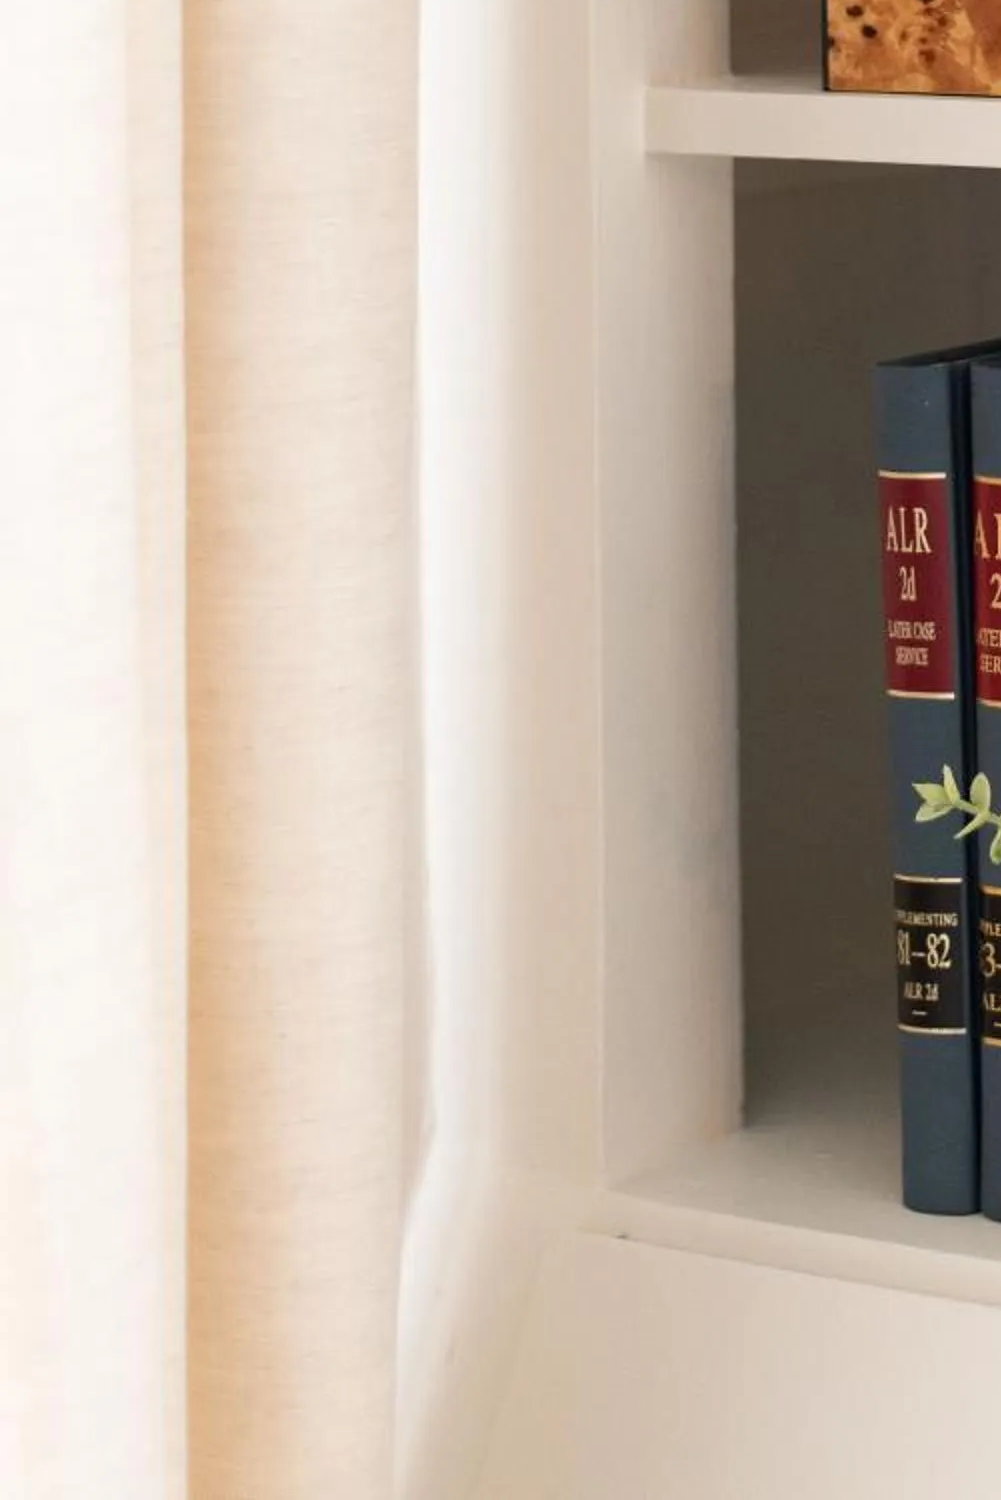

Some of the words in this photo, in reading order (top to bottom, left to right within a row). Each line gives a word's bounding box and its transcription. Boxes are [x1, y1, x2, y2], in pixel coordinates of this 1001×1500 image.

[886, 507, 932, 554] ALR
[900, 566, 917, 601] 2d
[913, 621, 936, 641] CASE
[896, 646, 929, 666] SERVICE
